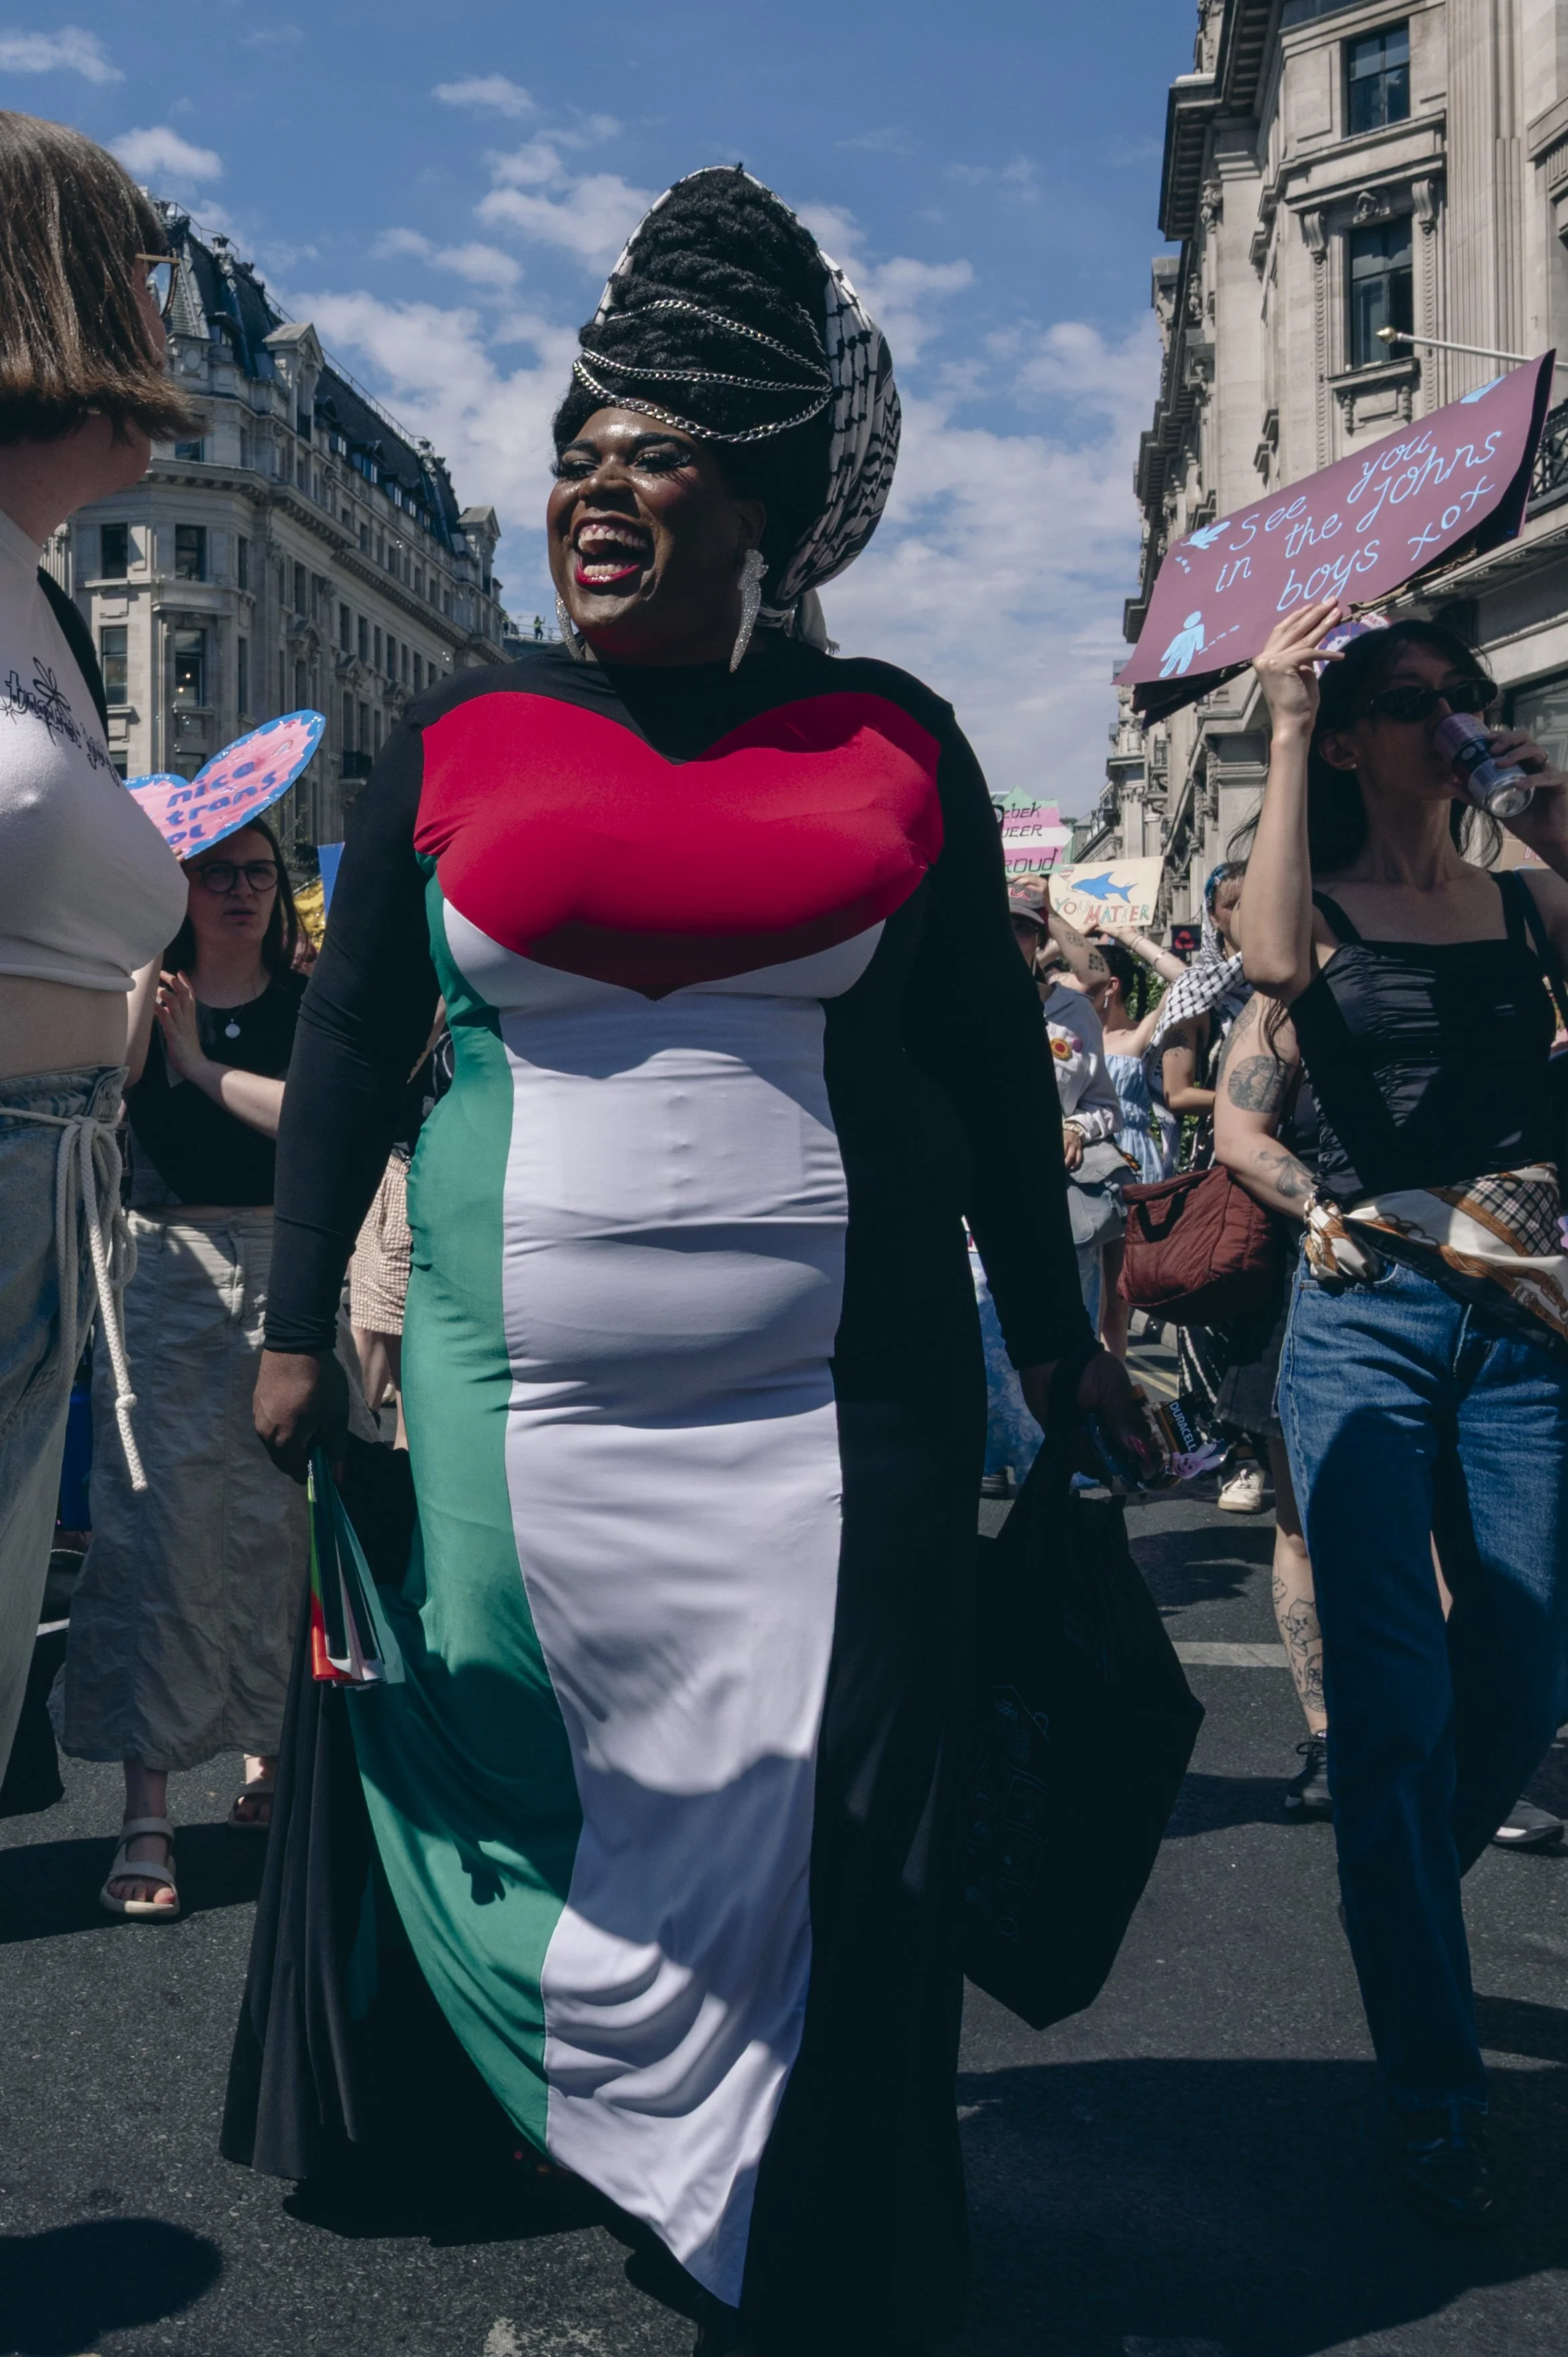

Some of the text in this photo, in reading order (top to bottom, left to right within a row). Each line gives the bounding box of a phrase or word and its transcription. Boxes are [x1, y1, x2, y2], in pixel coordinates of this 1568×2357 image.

[1347, 430, 1432, 504] you
[1215, 556, 1252, 592] in
[1285, 512, 1344, 558] the
[1276, 476, 1494, 612] boys xox
[166, 769, 277, 827] trans
[167, 761, 255, 808] nice
[1002, 824, 1042, 838] UEER
[1054, 897, 1150, 925] YOU MATTER
[1169, 1401, 1197, 1452] DURACELL
